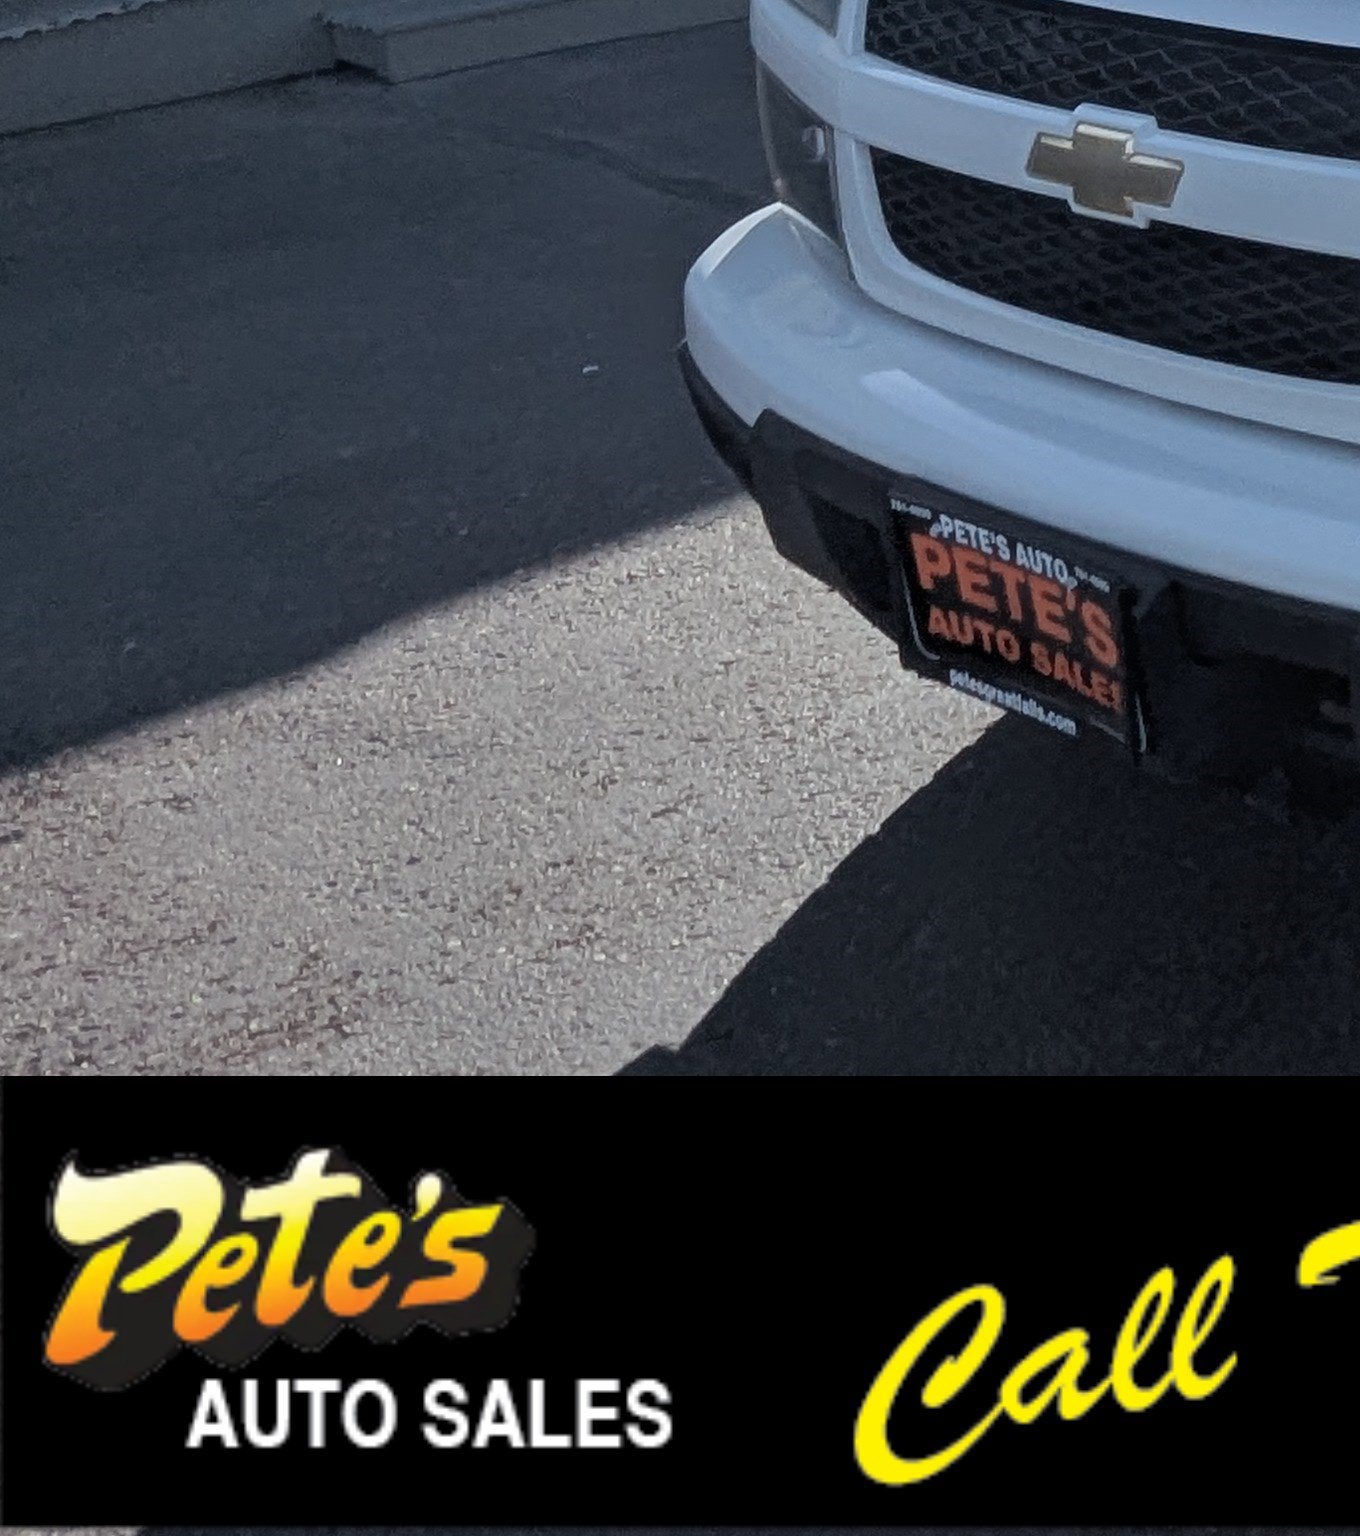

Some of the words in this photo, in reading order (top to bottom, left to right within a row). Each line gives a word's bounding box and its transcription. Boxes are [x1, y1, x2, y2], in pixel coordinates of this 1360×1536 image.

[939, 514, 1010, 561] PETE'S
[1016, 542, 1068, 583] AUTO
[910, 532, 1117, 668] PETE'S
[928, 605, 1020, 662] AUTO
